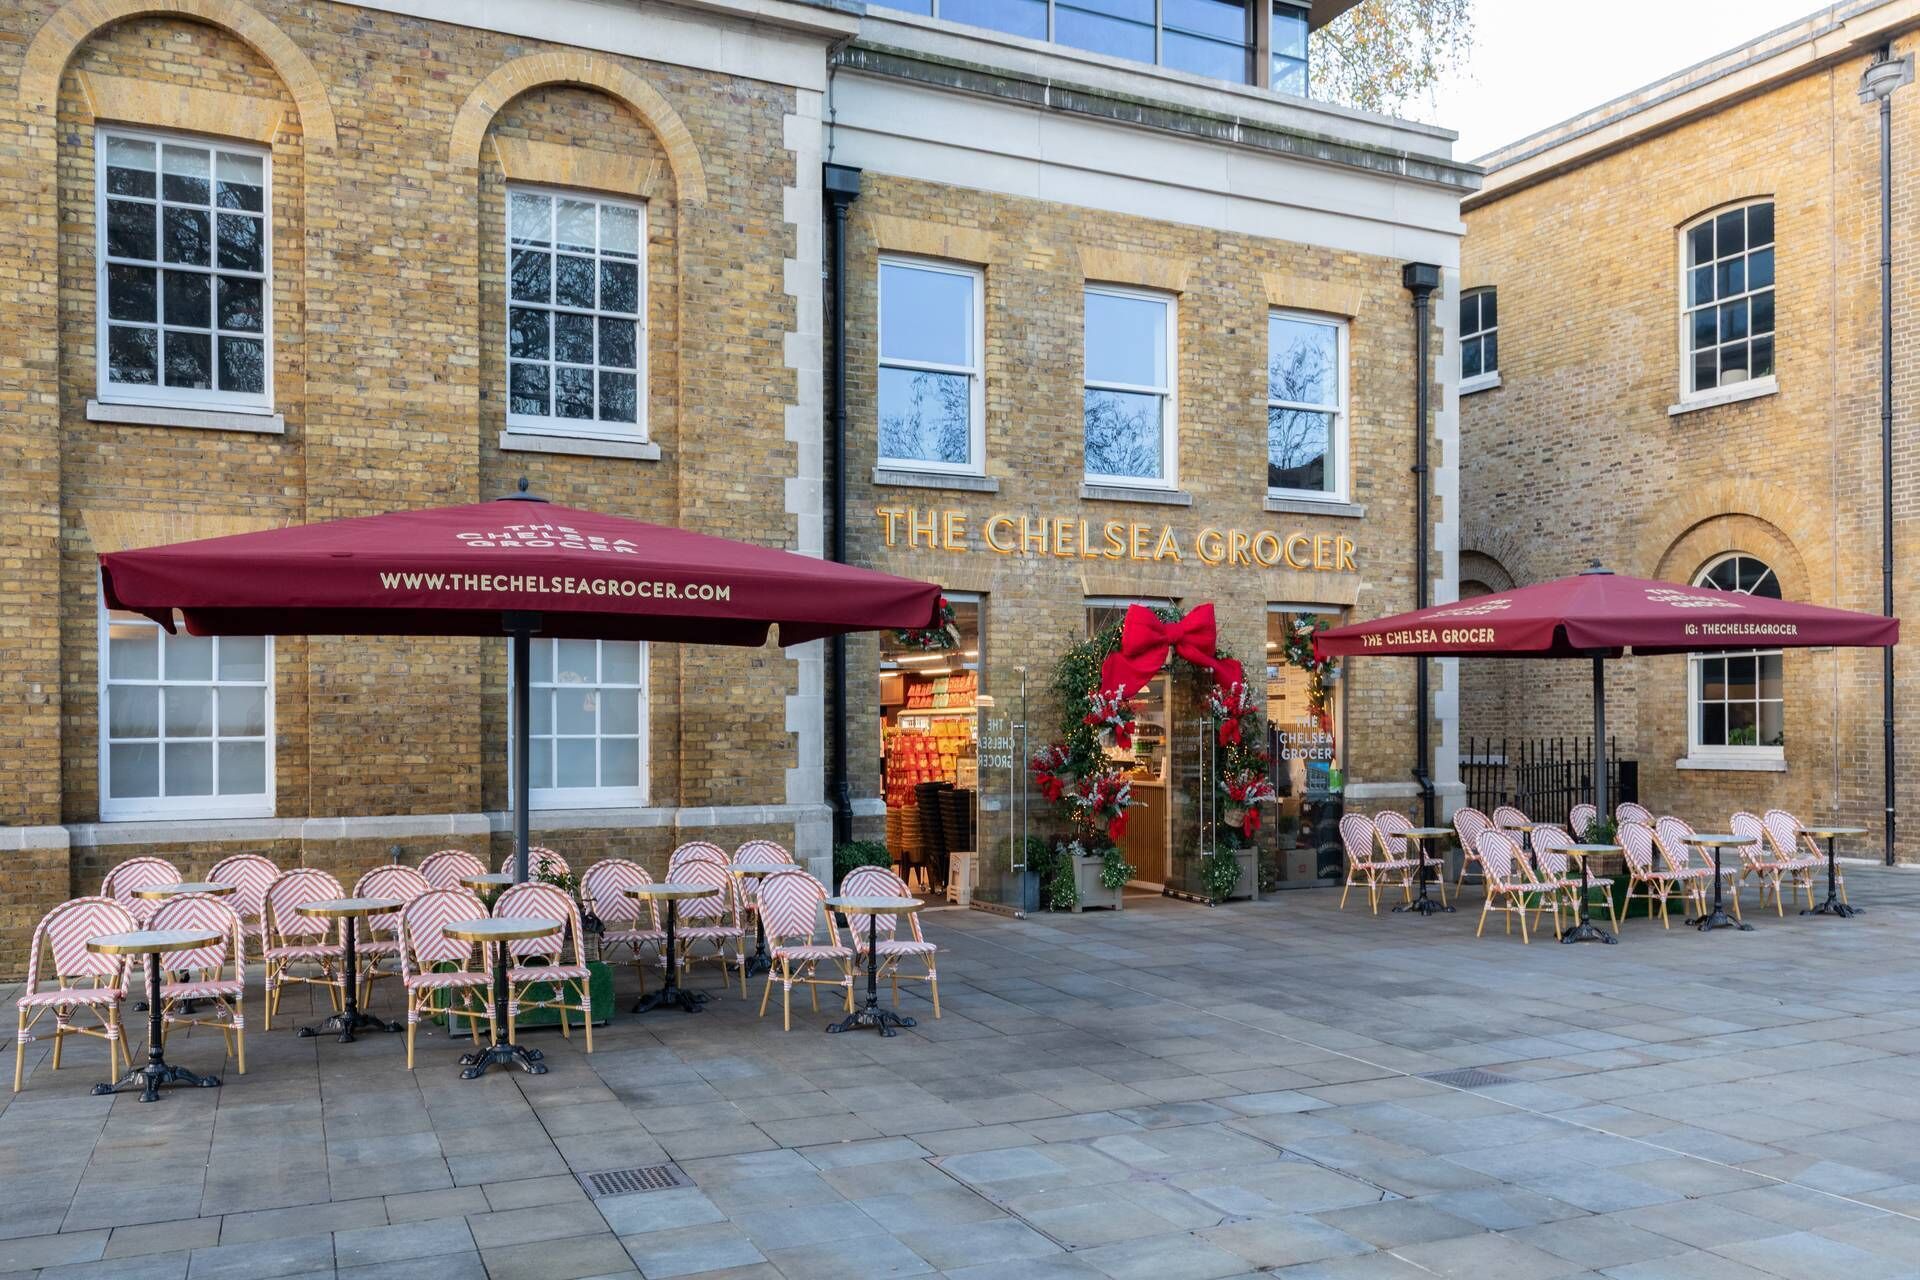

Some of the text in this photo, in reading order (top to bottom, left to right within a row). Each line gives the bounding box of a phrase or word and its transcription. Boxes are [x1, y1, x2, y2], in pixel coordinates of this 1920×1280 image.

[503, 524, 578, 534] THE
[456, 532, 638, 547] CHELSEA
[877, 505, 1359, 572] THE CHELSEA GROCER
[466, 540, 638, 554] GROCER
[380, 572, 731, 601] WWW.THECHELSEAGROCER.COM
[1685, 623, 1798, 636] IG: THECHELSEAGROCER
[1361, 628, 1495, 647] THE CHELSEA GROCER
[1296, 716, 1318, 728] THE
[1280, 732, 1334, 744] CHELSEA
[1281, 748, 1332, 760] GROCER
